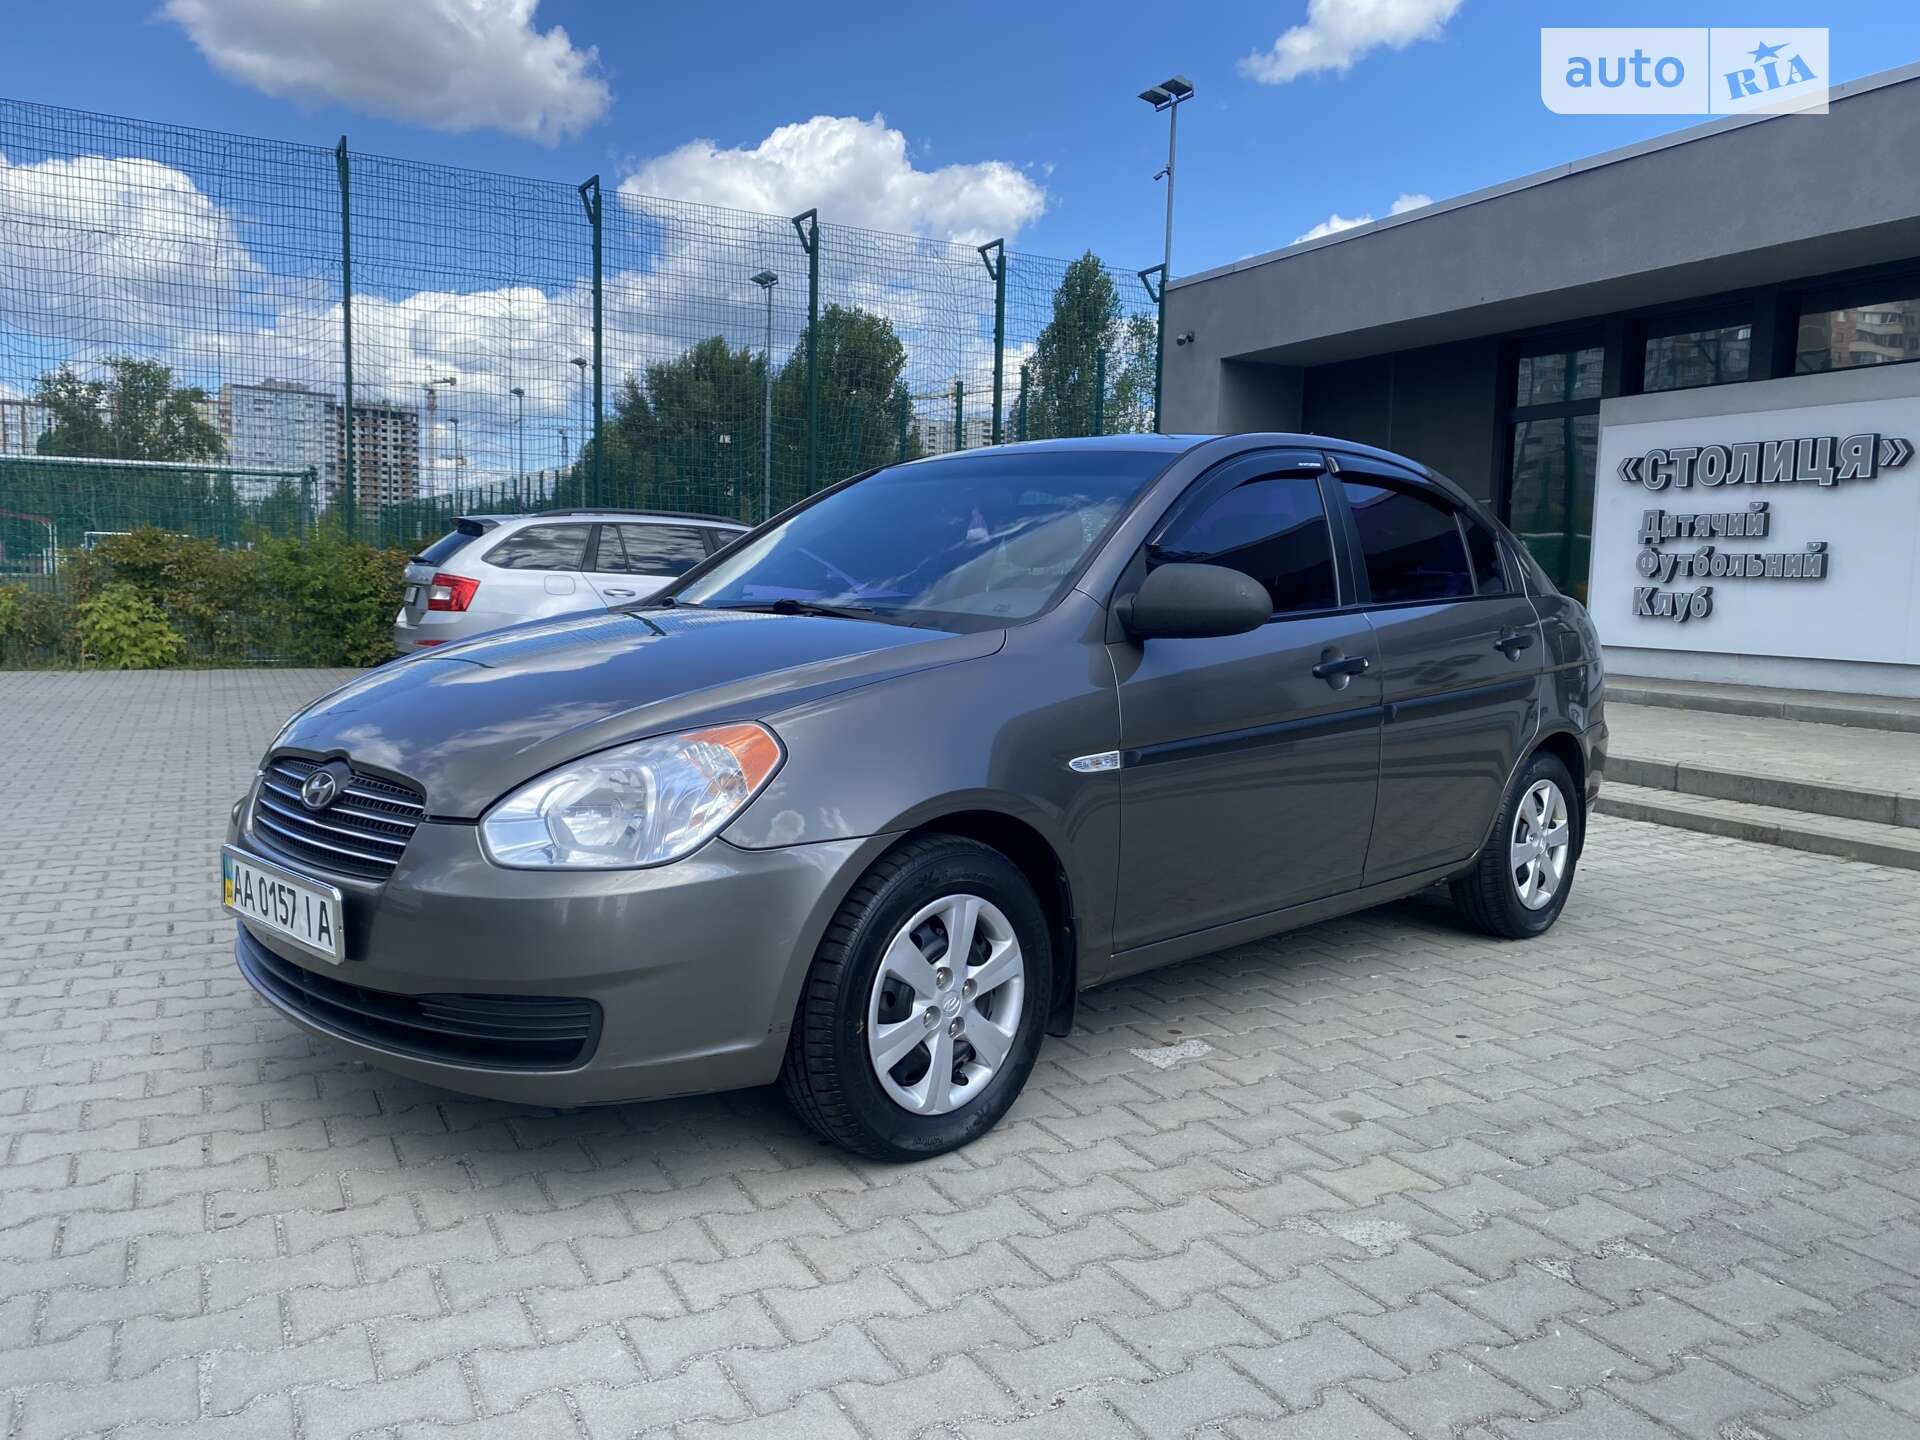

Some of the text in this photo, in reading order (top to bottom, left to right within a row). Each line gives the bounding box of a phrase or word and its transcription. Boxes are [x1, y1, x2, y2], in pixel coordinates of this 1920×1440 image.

[1616, 433, 1915, 491] «СТОЛИЦЯ»
[1638, 501, 1770, 544] Дитячий
[1636, 542, 1829, 583] Футбольний
[1632, 586, 1713, 622] Клуб
[233, 865, 333, 947] AA 0157 IA
